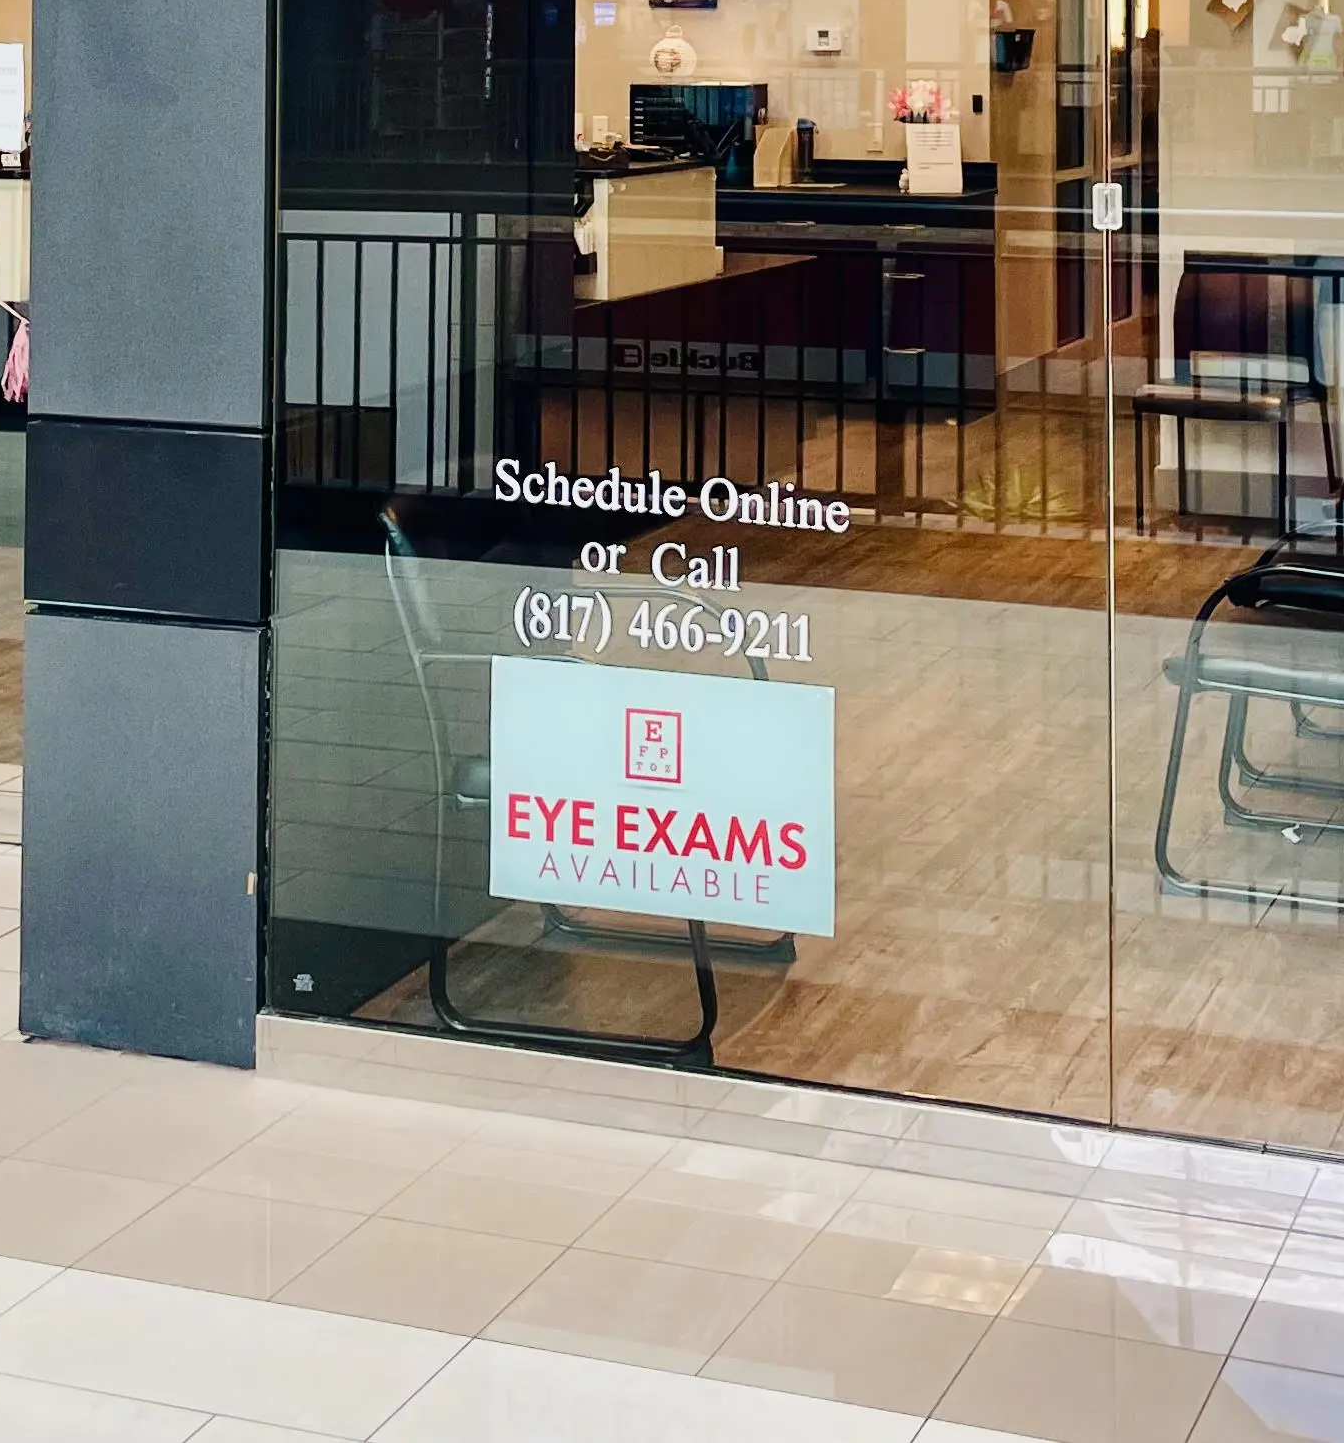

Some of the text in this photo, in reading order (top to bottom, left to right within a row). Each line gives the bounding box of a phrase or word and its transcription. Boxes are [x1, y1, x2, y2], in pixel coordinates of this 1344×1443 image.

[495, 457, 851, 533] Schedule Online
[580, 540, 741, 593] or Call
[513, 586, 813, 662] (817) 466-9211
[639, 745, 669, 759] F P
[645, 720, 662, 742] E
[507, 793, 808, 871] EYE EXAMS
[538, 850, 771, 905] AVAILABLE
